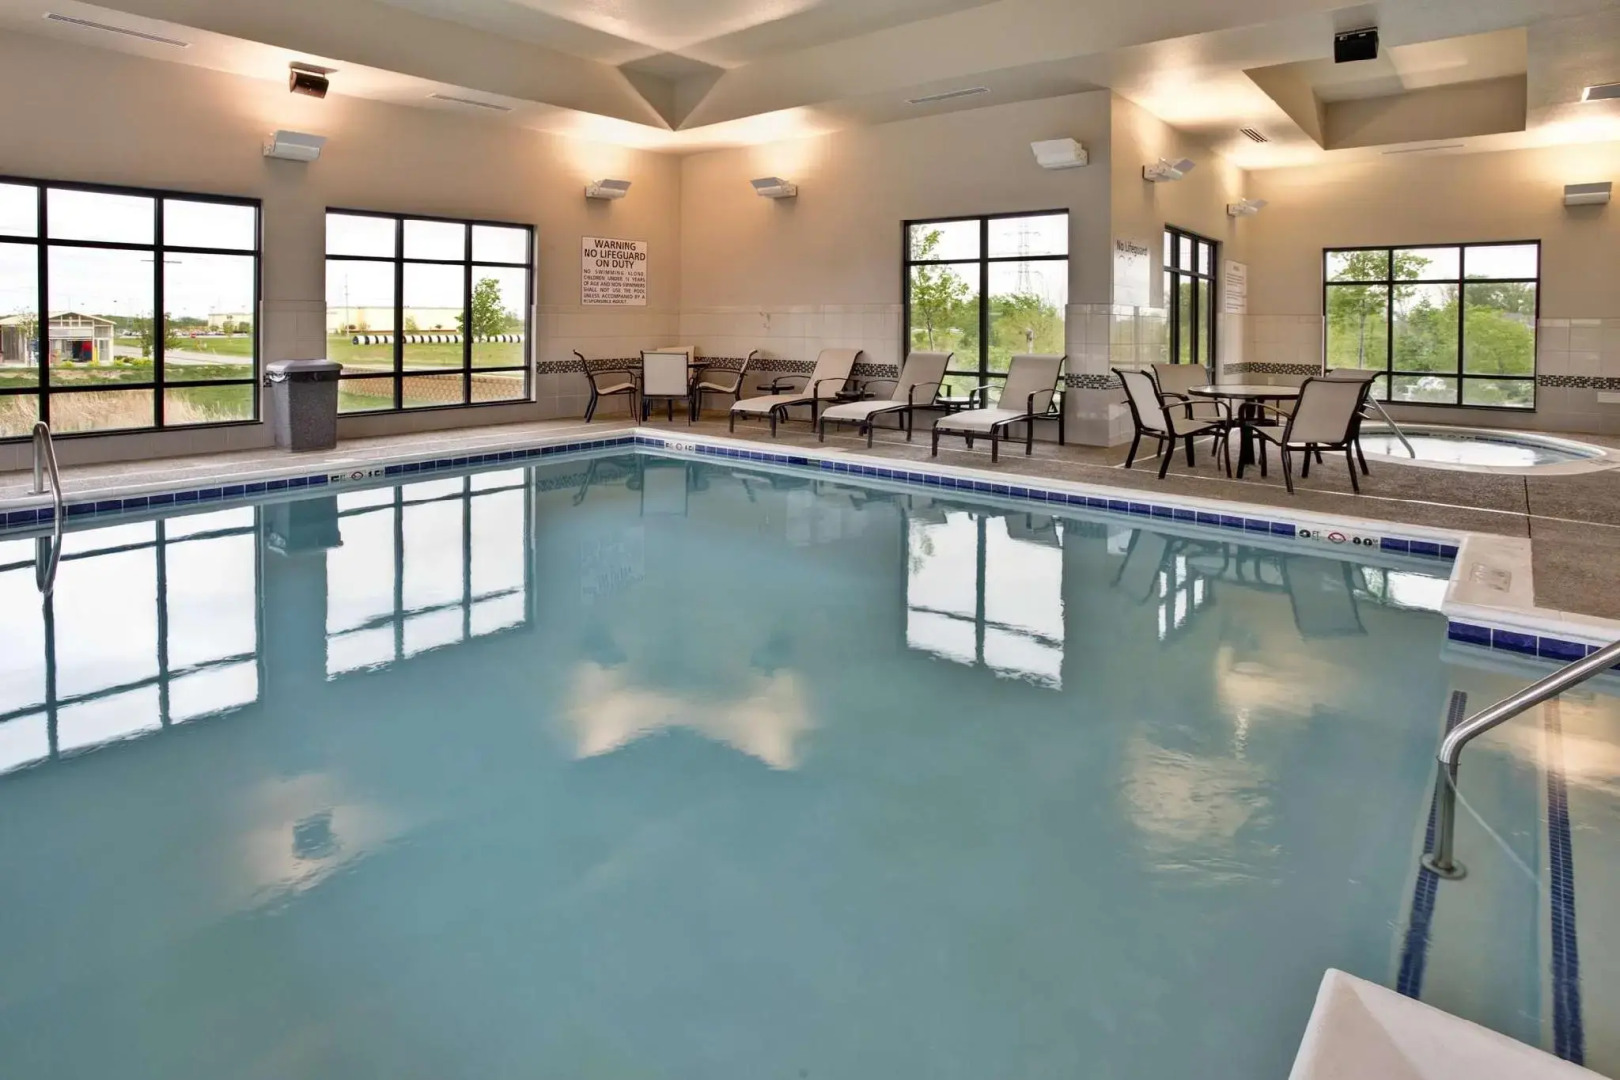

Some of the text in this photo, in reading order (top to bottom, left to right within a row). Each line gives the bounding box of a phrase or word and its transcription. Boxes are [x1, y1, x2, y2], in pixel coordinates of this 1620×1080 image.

[595, 240, 636, 251] WARNING
[1116, 240, 1148, 257] No Lifeguard
[584, 249, 645, 261] NO LIFEGUARD
[596, 259, 634, 269] ON DUTY
